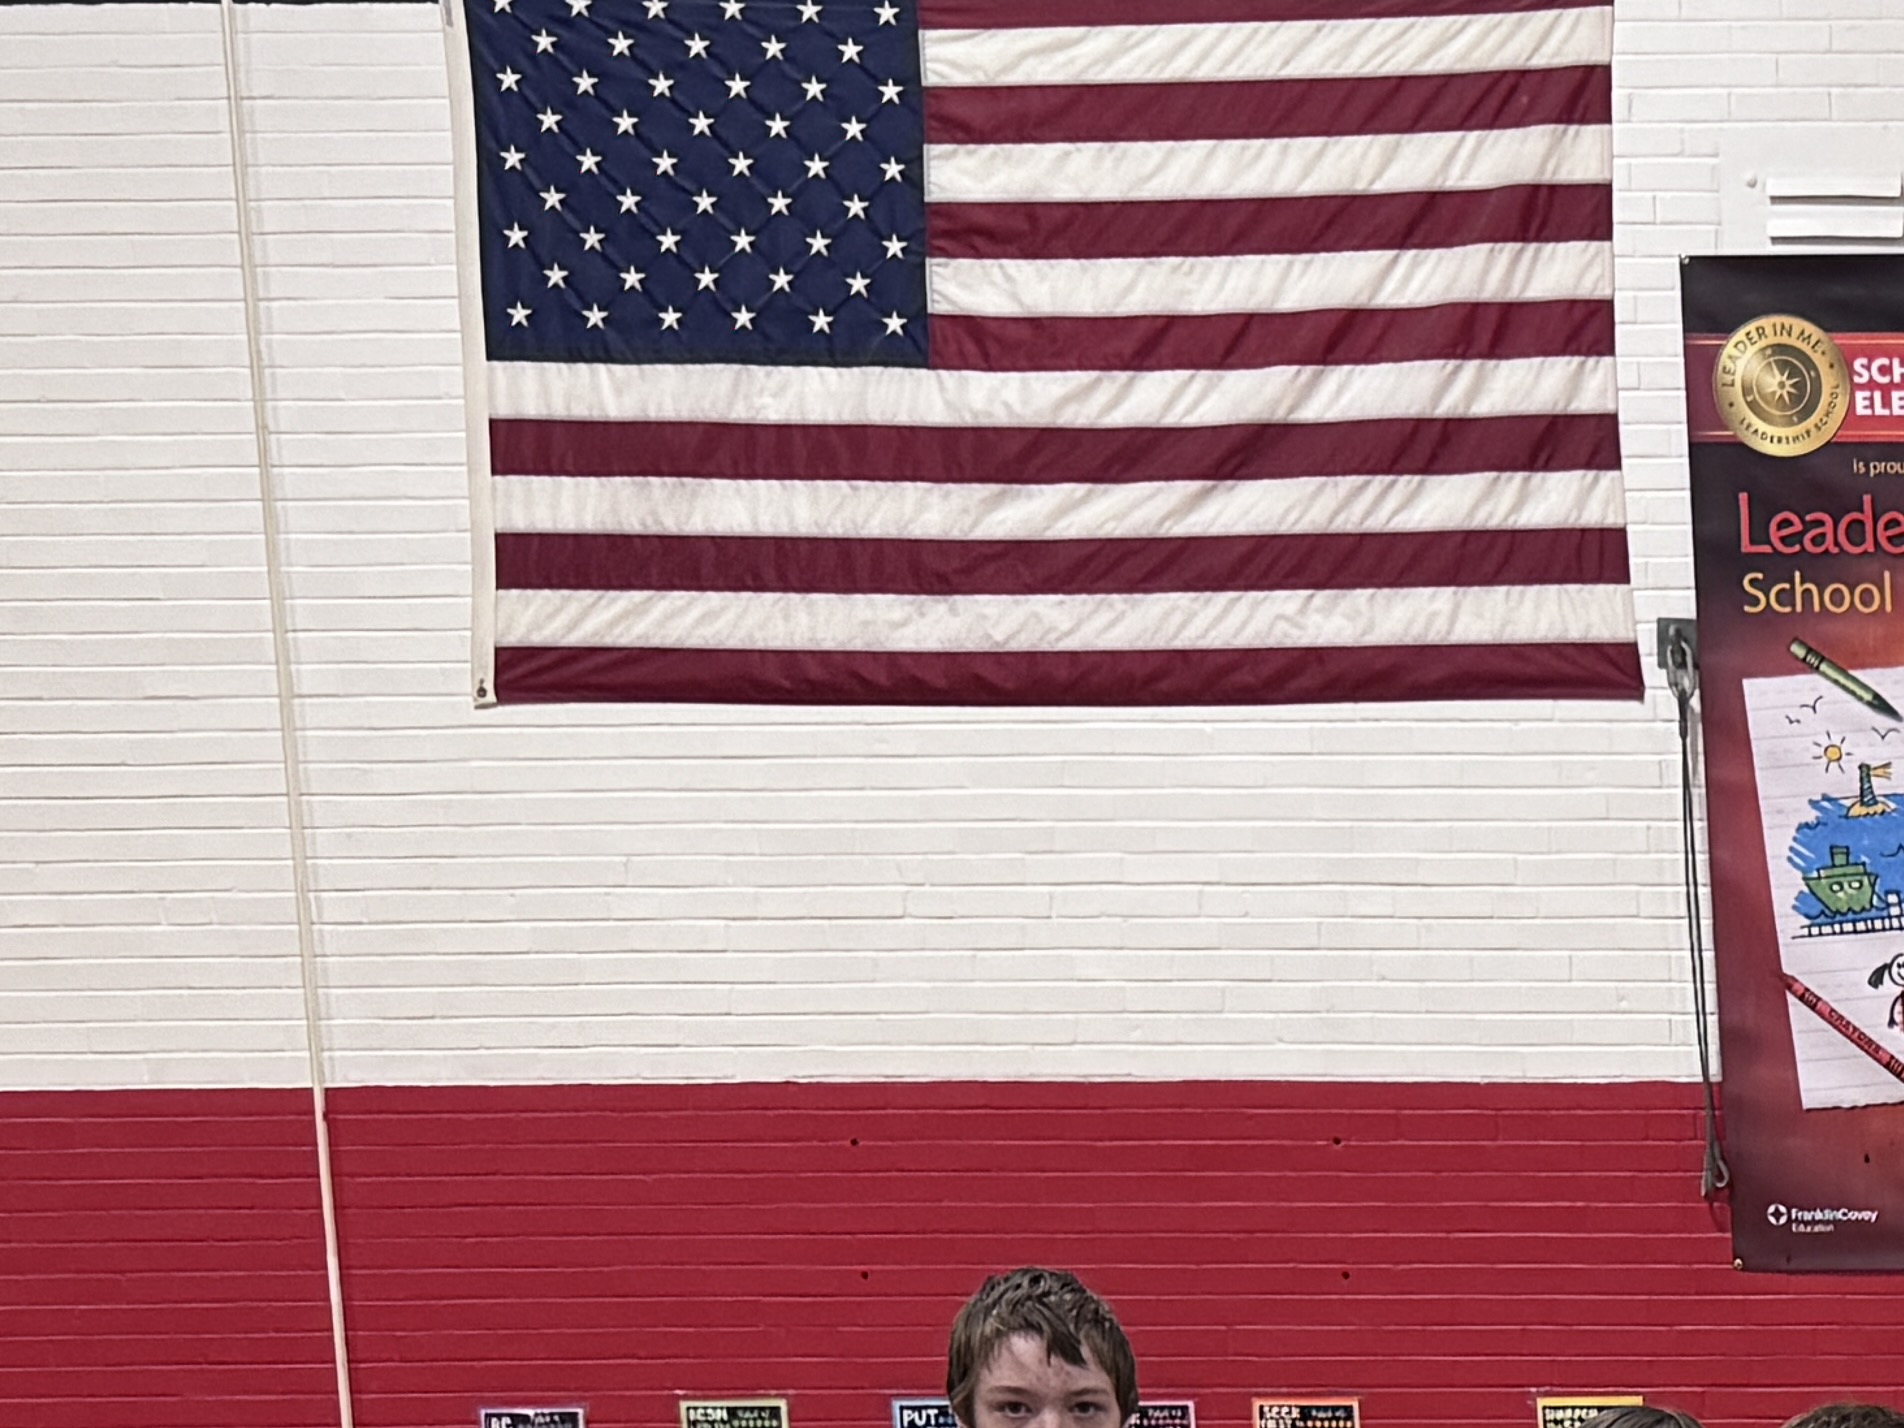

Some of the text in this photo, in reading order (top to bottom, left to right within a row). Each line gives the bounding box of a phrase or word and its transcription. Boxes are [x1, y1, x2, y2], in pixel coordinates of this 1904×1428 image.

[1722, 325, 1767, 387] LEADER
[1772, 322, 1793, 337] IN
[1739, 383, 1840, 444] LEADERSHIP SCHOOL
[1743, 570, 1893, 614] School
[1791, 1208, 1878, 1223] FranklinCovey
[902, 1409, 938, 1427] PUT
